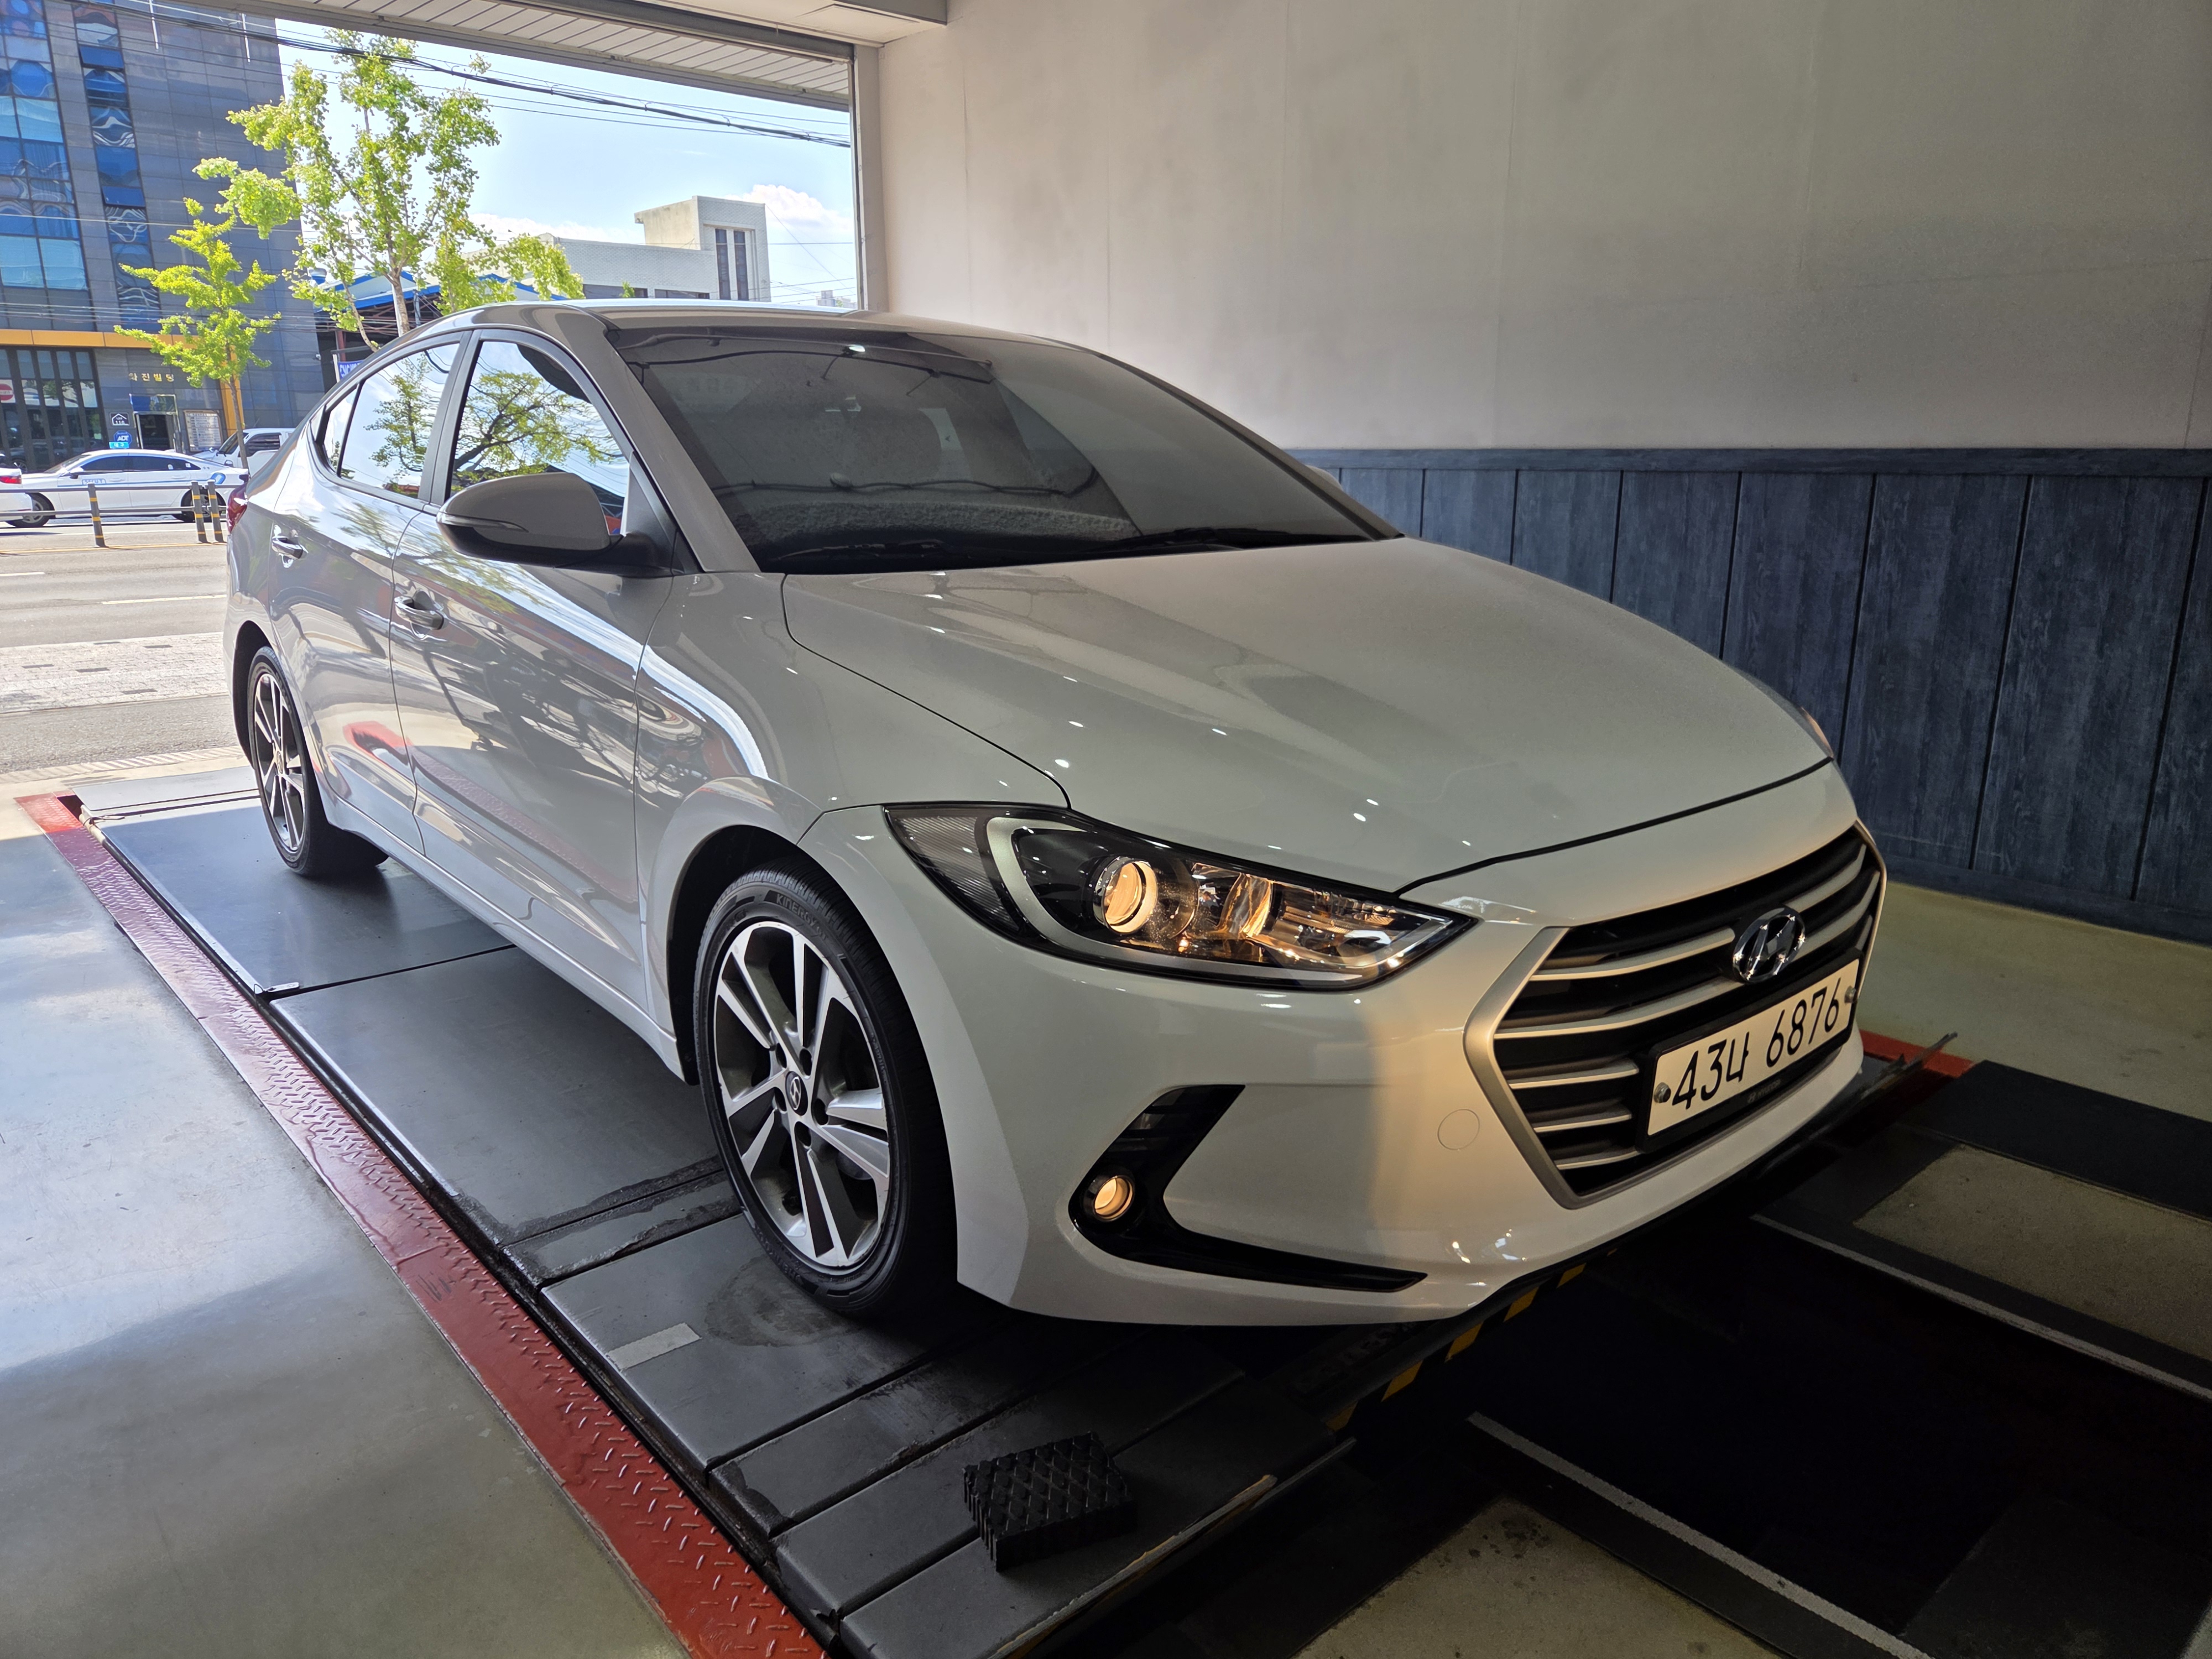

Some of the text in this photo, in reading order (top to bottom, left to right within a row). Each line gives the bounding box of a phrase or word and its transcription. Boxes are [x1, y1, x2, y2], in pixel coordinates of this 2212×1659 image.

[776, 894, 817, 927] KINERGY
[1672, 977, 1841, 1110] 43나 6876
